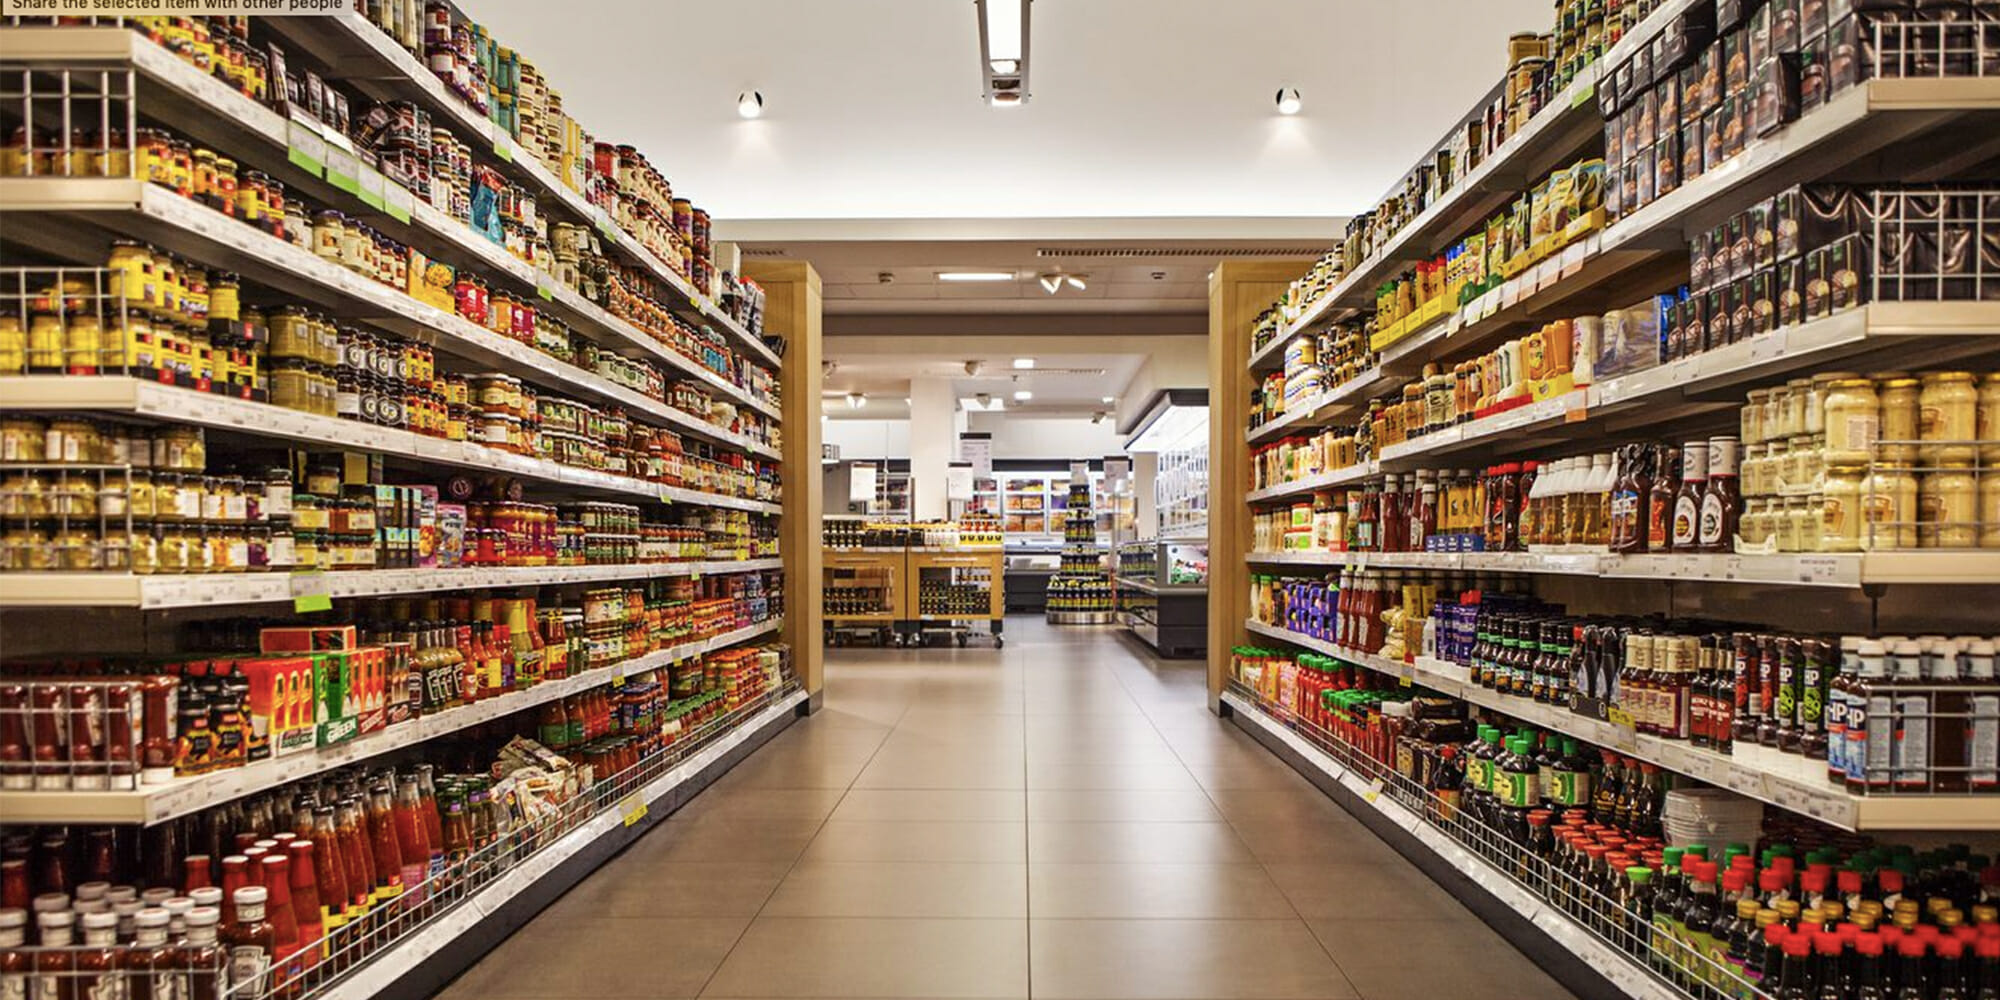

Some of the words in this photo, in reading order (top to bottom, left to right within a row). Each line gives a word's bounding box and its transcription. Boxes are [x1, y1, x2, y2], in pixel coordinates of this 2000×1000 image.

[1780, 667, 1793, 681] HP
[1804, 669, 1820, 685] HP
[1829, 702, 1848, 722] HP
[1847, 708, 1865, 728] HP
